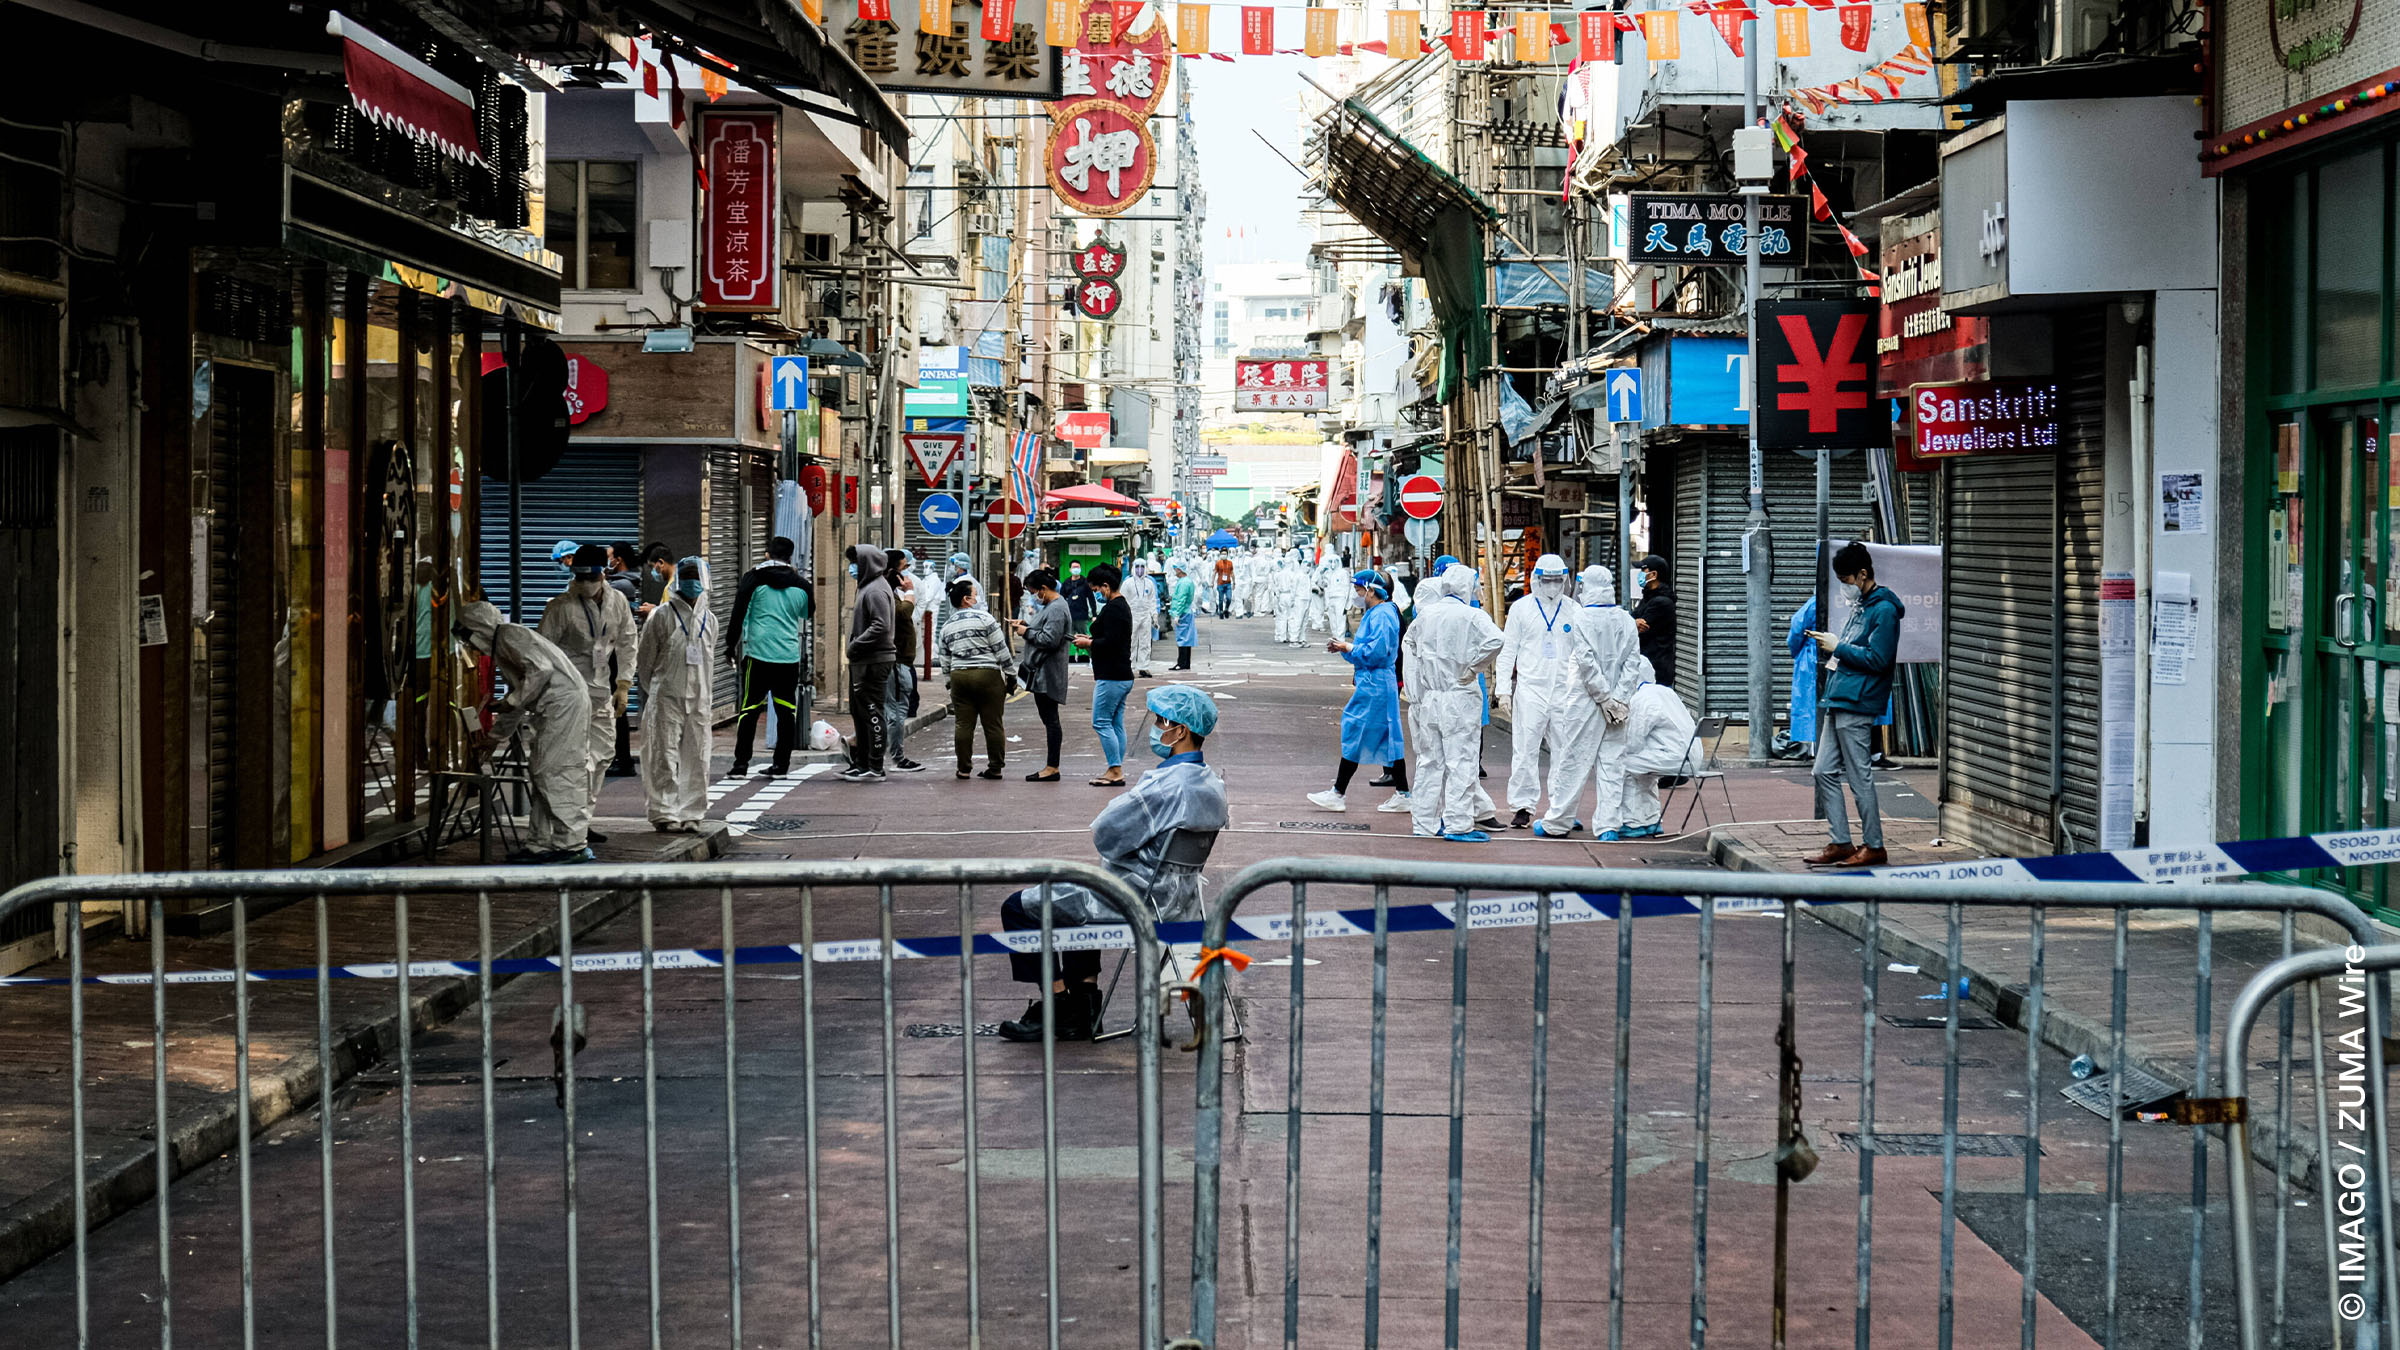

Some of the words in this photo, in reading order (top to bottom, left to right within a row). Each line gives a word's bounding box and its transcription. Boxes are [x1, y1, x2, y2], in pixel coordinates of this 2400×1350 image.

[1060, 117, 1139, 199] 押
[725, 138, 749, 285] 潘芳堂涼茶
[1647, 202, 1702, 220] TIMA
[1709, 203, 1792, 222] MOILE
[1644, 222, 1791, 257] 天馬電訊
[1882, 256, 1917, 304] Sanskriti
[1084, 281, 1114, 312] 押
[1918, 385, 2056, 424] Sanskriti
[1919, 426, 2016, 452] Jewellers
[2110, 491, 2134, 518] 15
[2329, 835, 2380, 849] CROSS
[1948, 867, 1978, 880] NOT
[1982, 865, 2003, 877] DO
[1451, 903, 1502, 915] CRO
[1472, 916, 1535, 927] CORDON
[1550, 912, 1592, 921] POLIC
[1008, 934, 1060, 945] COSS
[1068, 932, 1098, 942] NOT
[1102, 930, 1123, 940] DO
[575, 959, 617, 967] CROS
[658, 954, 681, 963] DO
